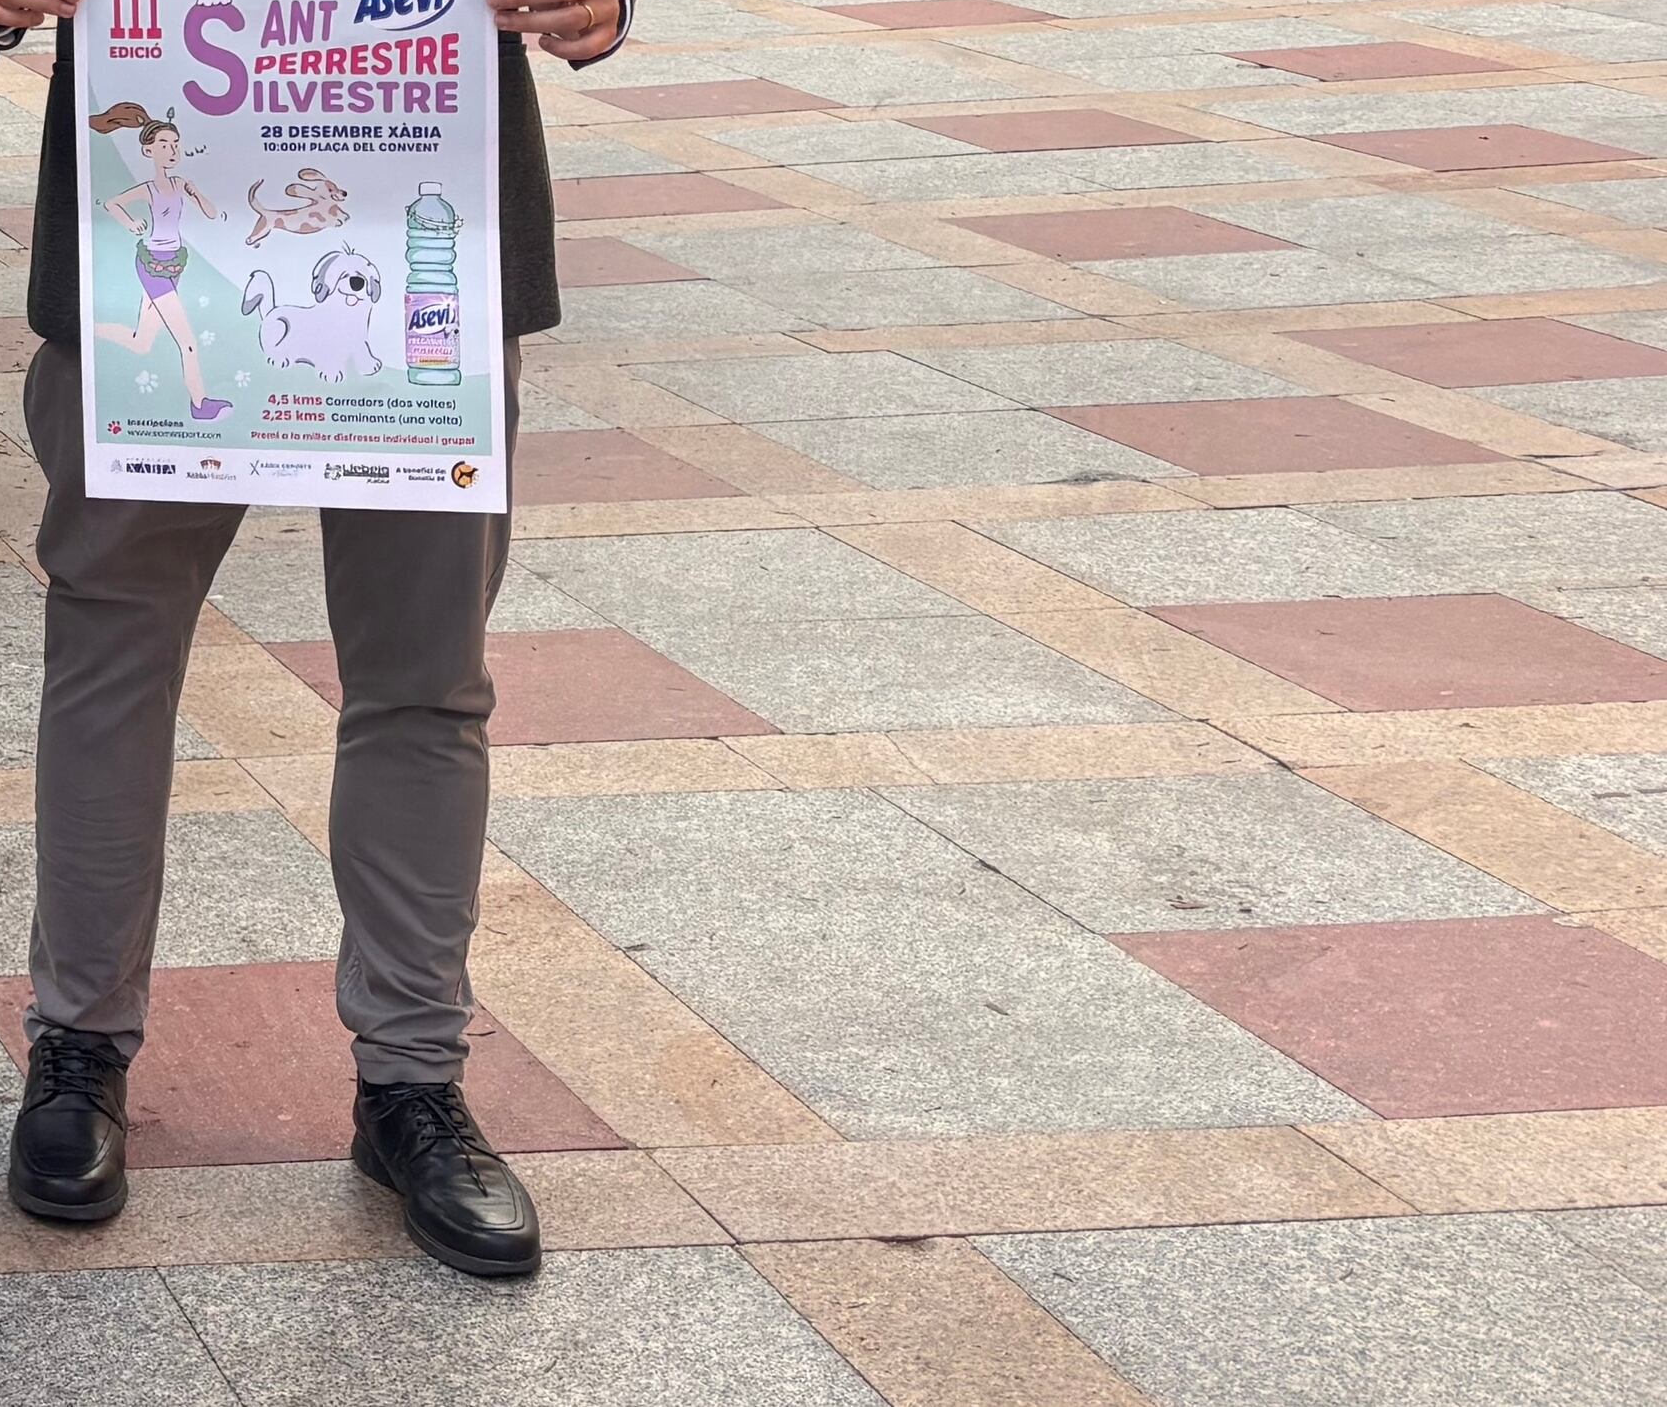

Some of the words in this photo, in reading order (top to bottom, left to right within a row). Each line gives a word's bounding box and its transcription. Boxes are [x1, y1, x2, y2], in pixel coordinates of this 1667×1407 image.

[109, 43, 162, 58] EDICIÓ
[253, 32, 459, 75] PERRESTRE
[260, 126, 282, 137] 28
[289, 125, 382, 138] DESEMBRE
[387, 122, 441, 138] XÀBIA
[263, 141, 305, 151] 10:00H
[309, 142, 349, 152] PLAÇA
[353, 142, 375, 151] DEL
[378, 142, 439, 152] CONVENT
[407, 302, 450, 331] Asevi
[267, 394, 289, 405] 4,5
[293, 394, 322, 405] kms
[325, 396, 383, 407] Corredors
[262, 409, 291, 421] 2,25
[296, 410, 325, 421] kms
